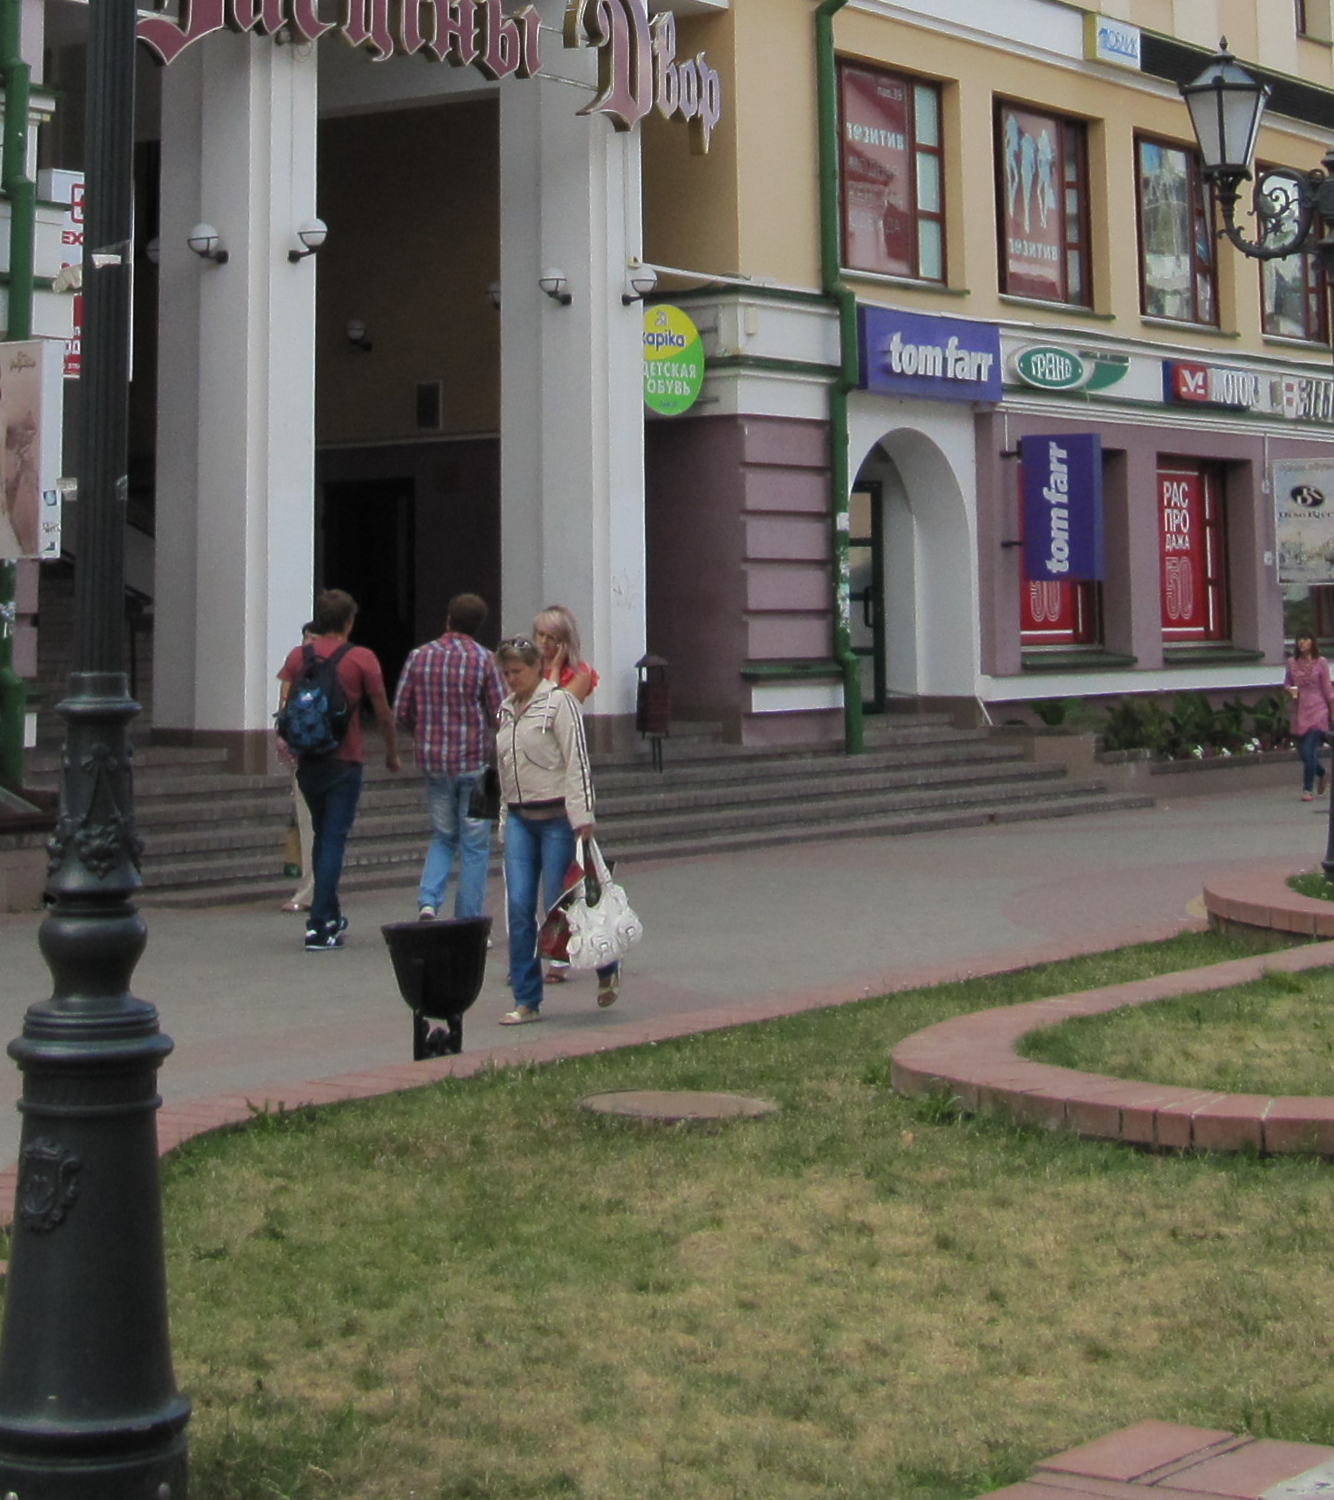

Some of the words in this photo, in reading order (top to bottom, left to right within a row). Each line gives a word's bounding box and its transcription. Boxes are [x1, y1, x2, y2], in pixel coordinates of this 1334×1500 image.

[889, 331, 943, 376] tom
[944, 335, 994, 382] farr
[647, 378, 692, 397] ОБУВЬ
[1042, 441, 1070, 505] farr
[1162, 480, 1190, 508] РАС
[1163, 507, 1190, 533] ПРО
[1045, 506, 1070, 574] tom
[1165, 532, 1191, 553] ДАЖА
[1165, 556, 1194, 620] 50
